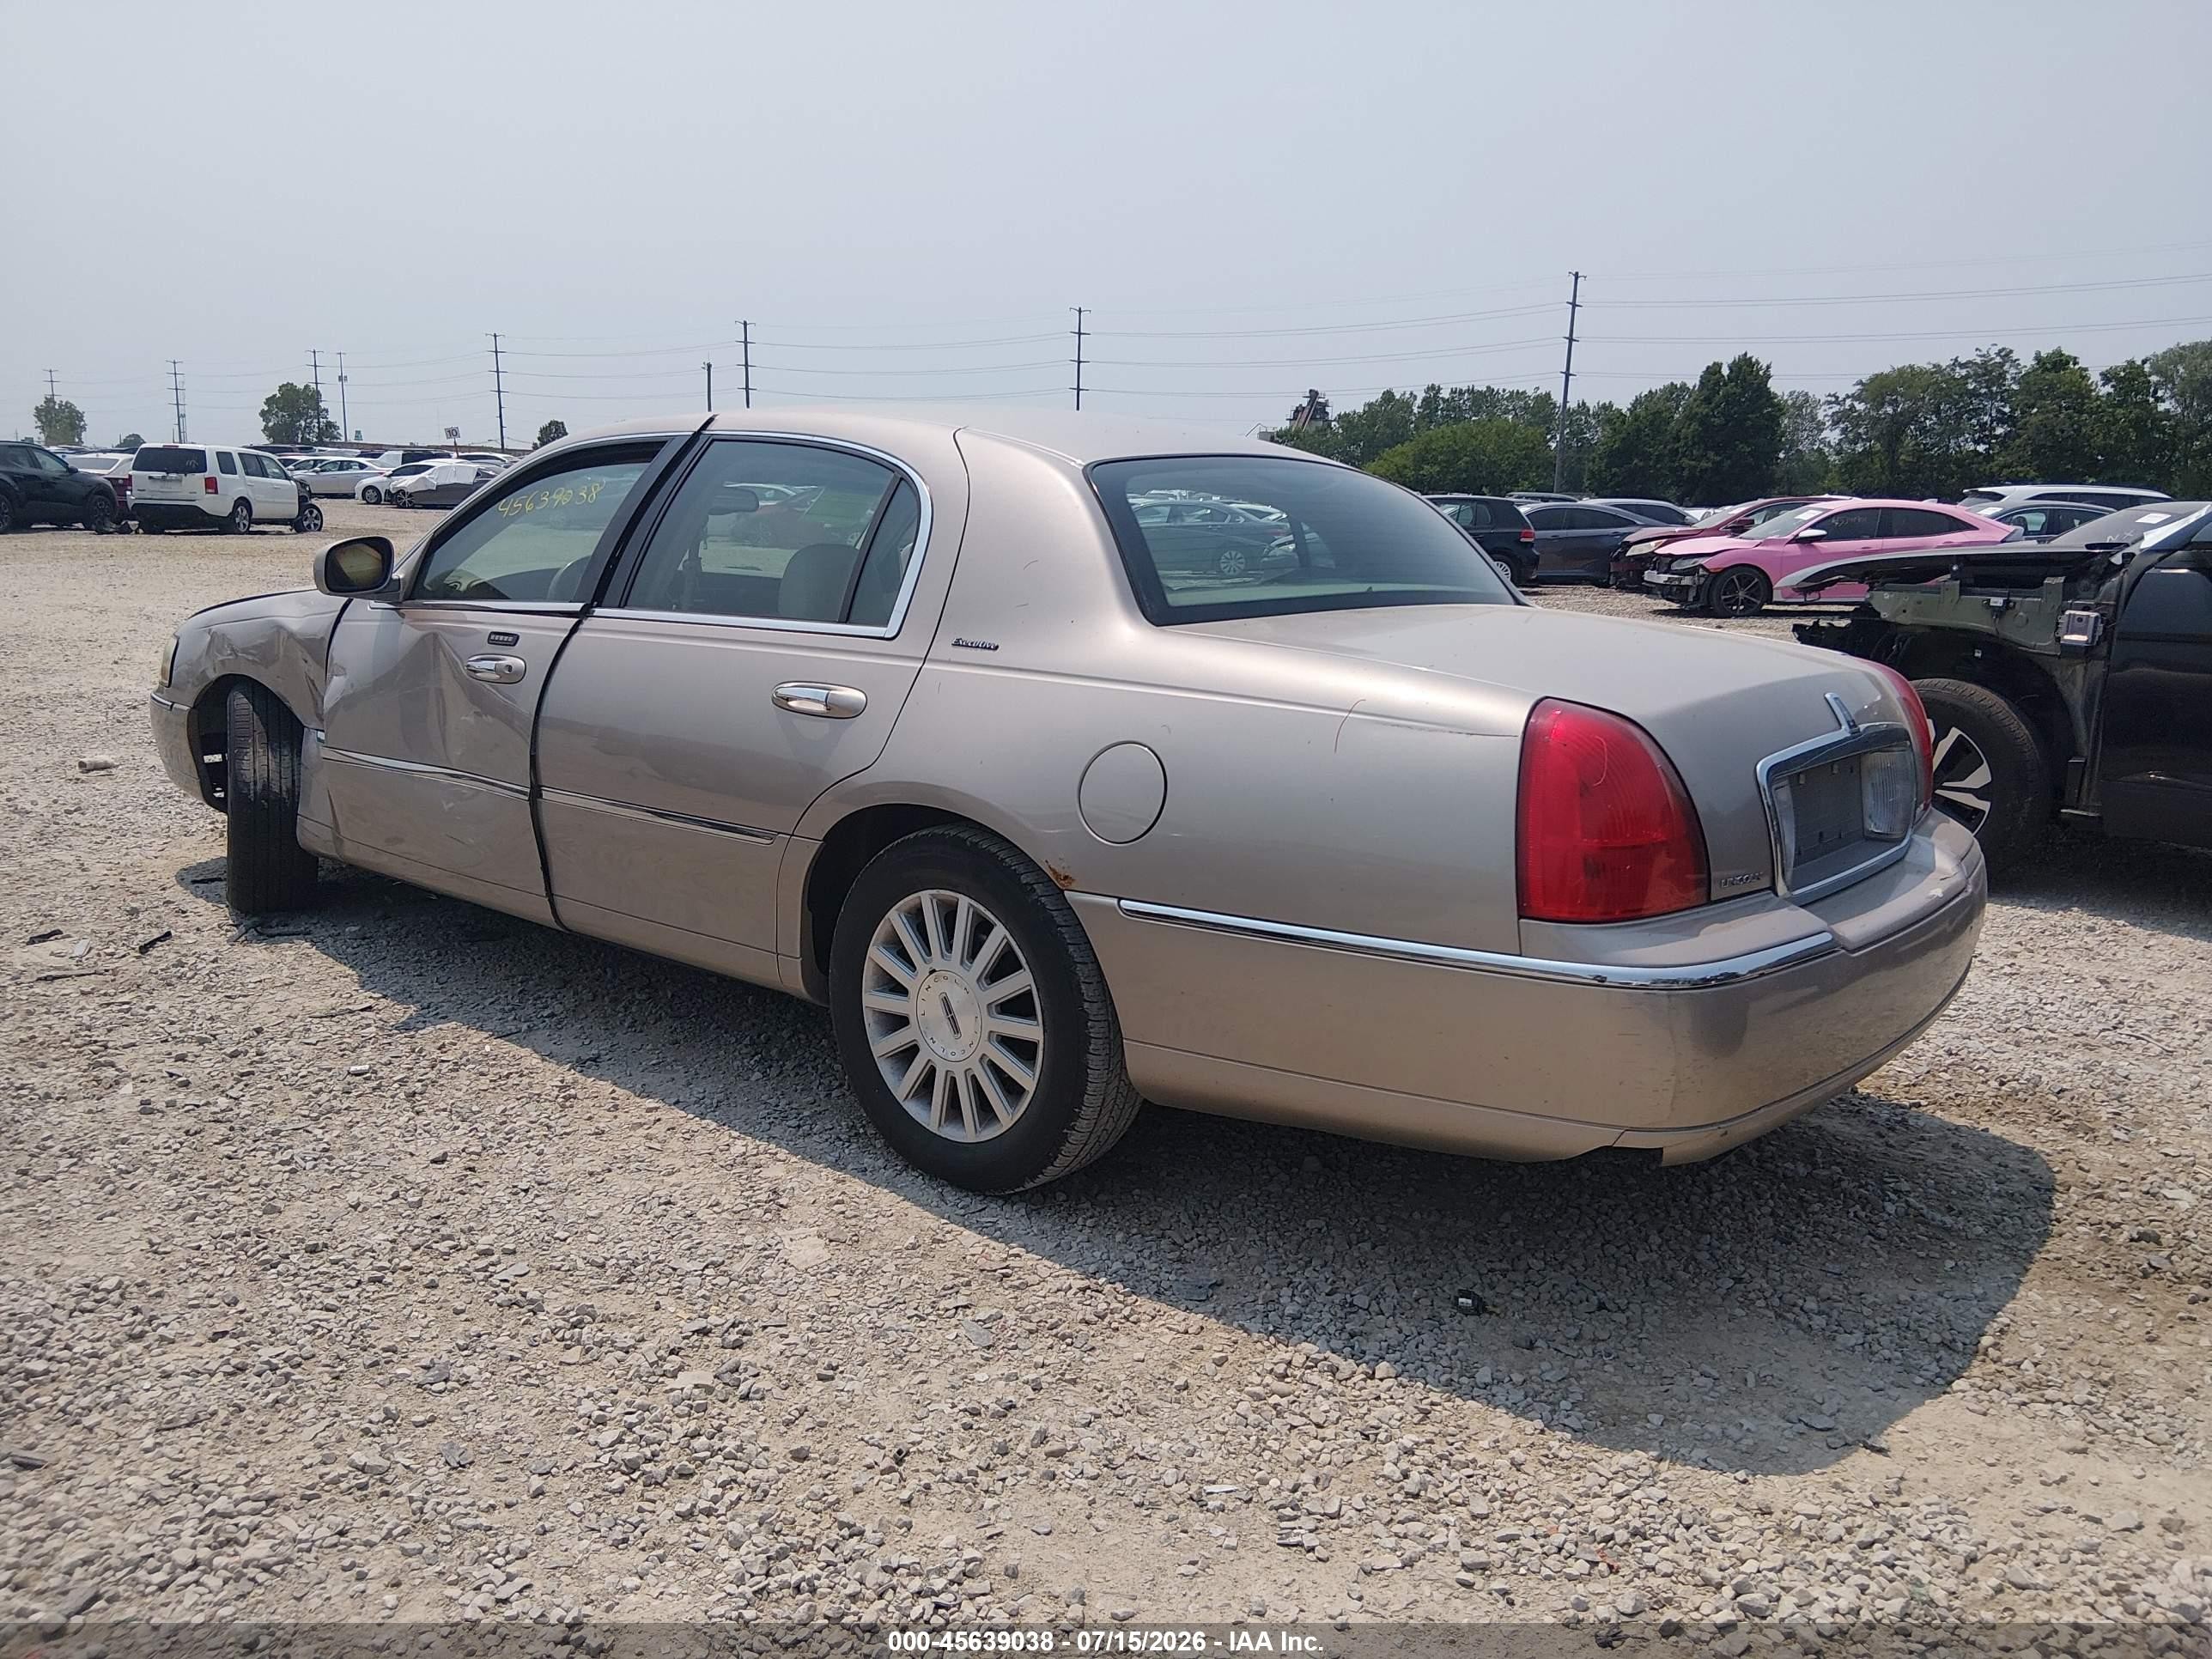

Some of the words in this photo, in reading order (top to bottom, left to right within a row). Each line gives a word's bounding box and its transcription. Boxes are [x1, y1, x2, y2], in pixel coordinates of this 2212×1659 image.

[447, 428, 458, 437] 10
[498, 478, 606, 518] 45639038
[921, 975, 969, 1017] LINCOLN
